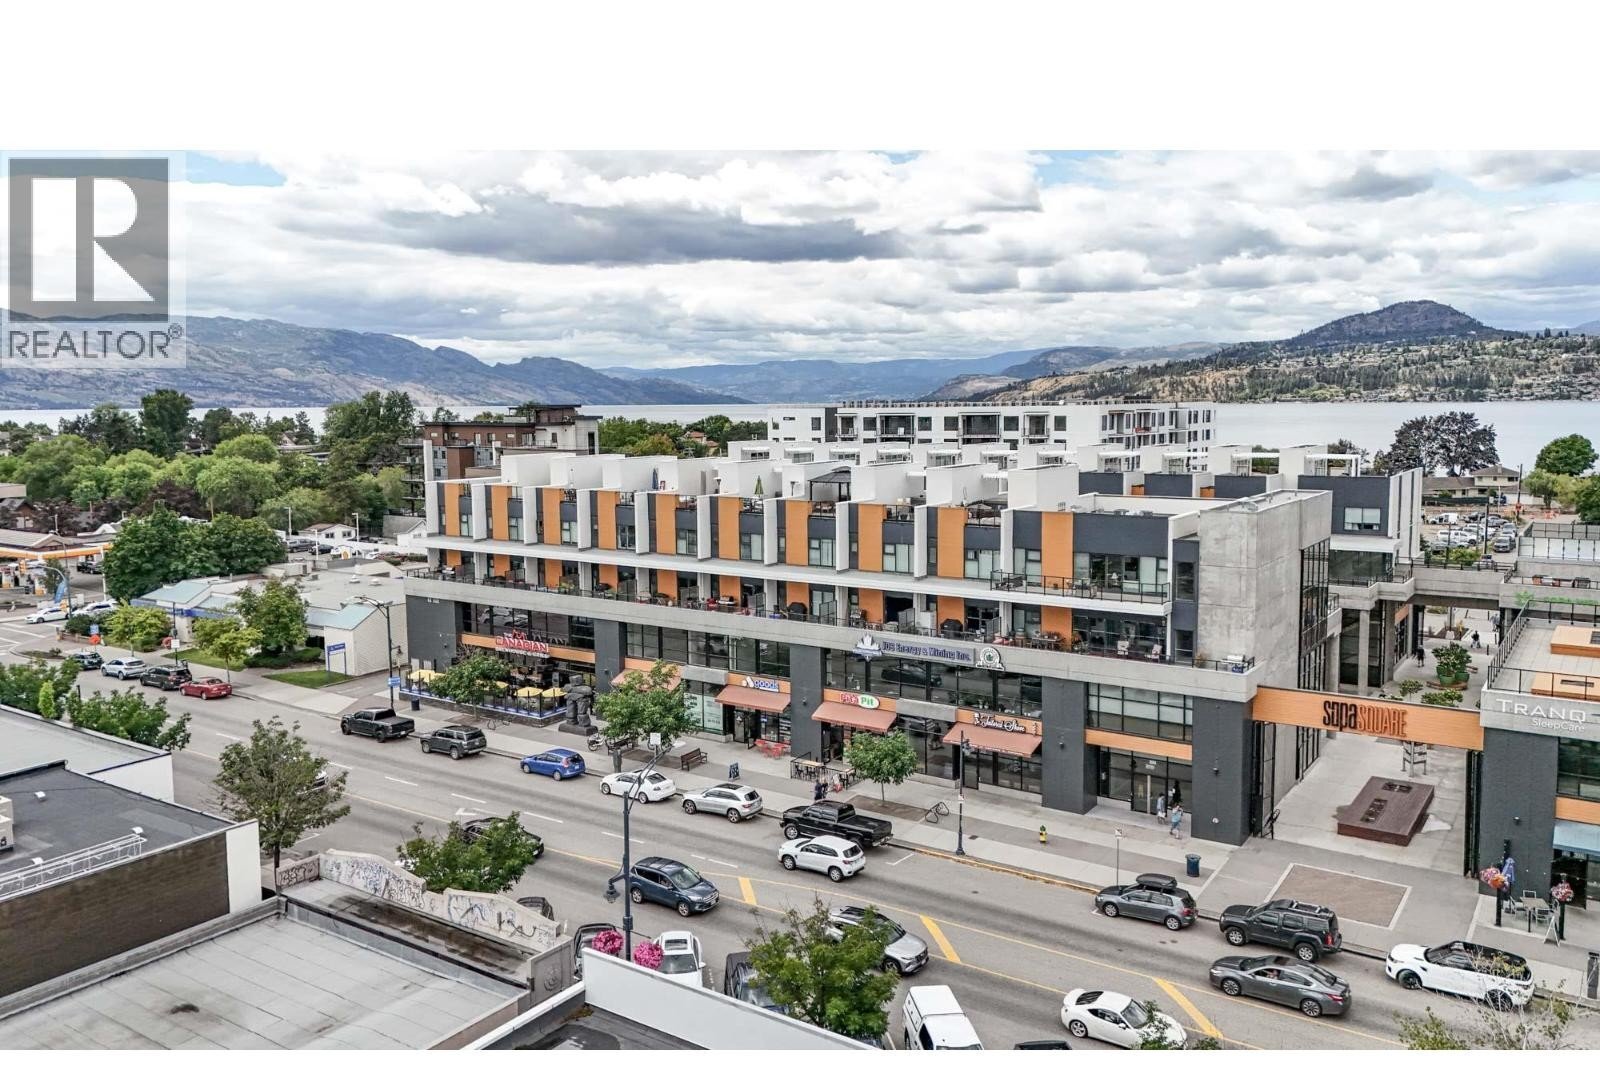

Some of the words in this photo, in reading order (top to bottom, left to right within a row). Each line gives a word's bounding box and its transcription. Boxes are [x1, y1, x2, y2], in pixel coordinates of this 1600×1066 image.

[496, 636, 549, 653] CANADIAN
[896, 642, 921, 656] Energy
[928, 646, 956, 660] Mining
[861, 696, 875, 706] Pit
[1496, 698, 1586, 724] TRANQ
